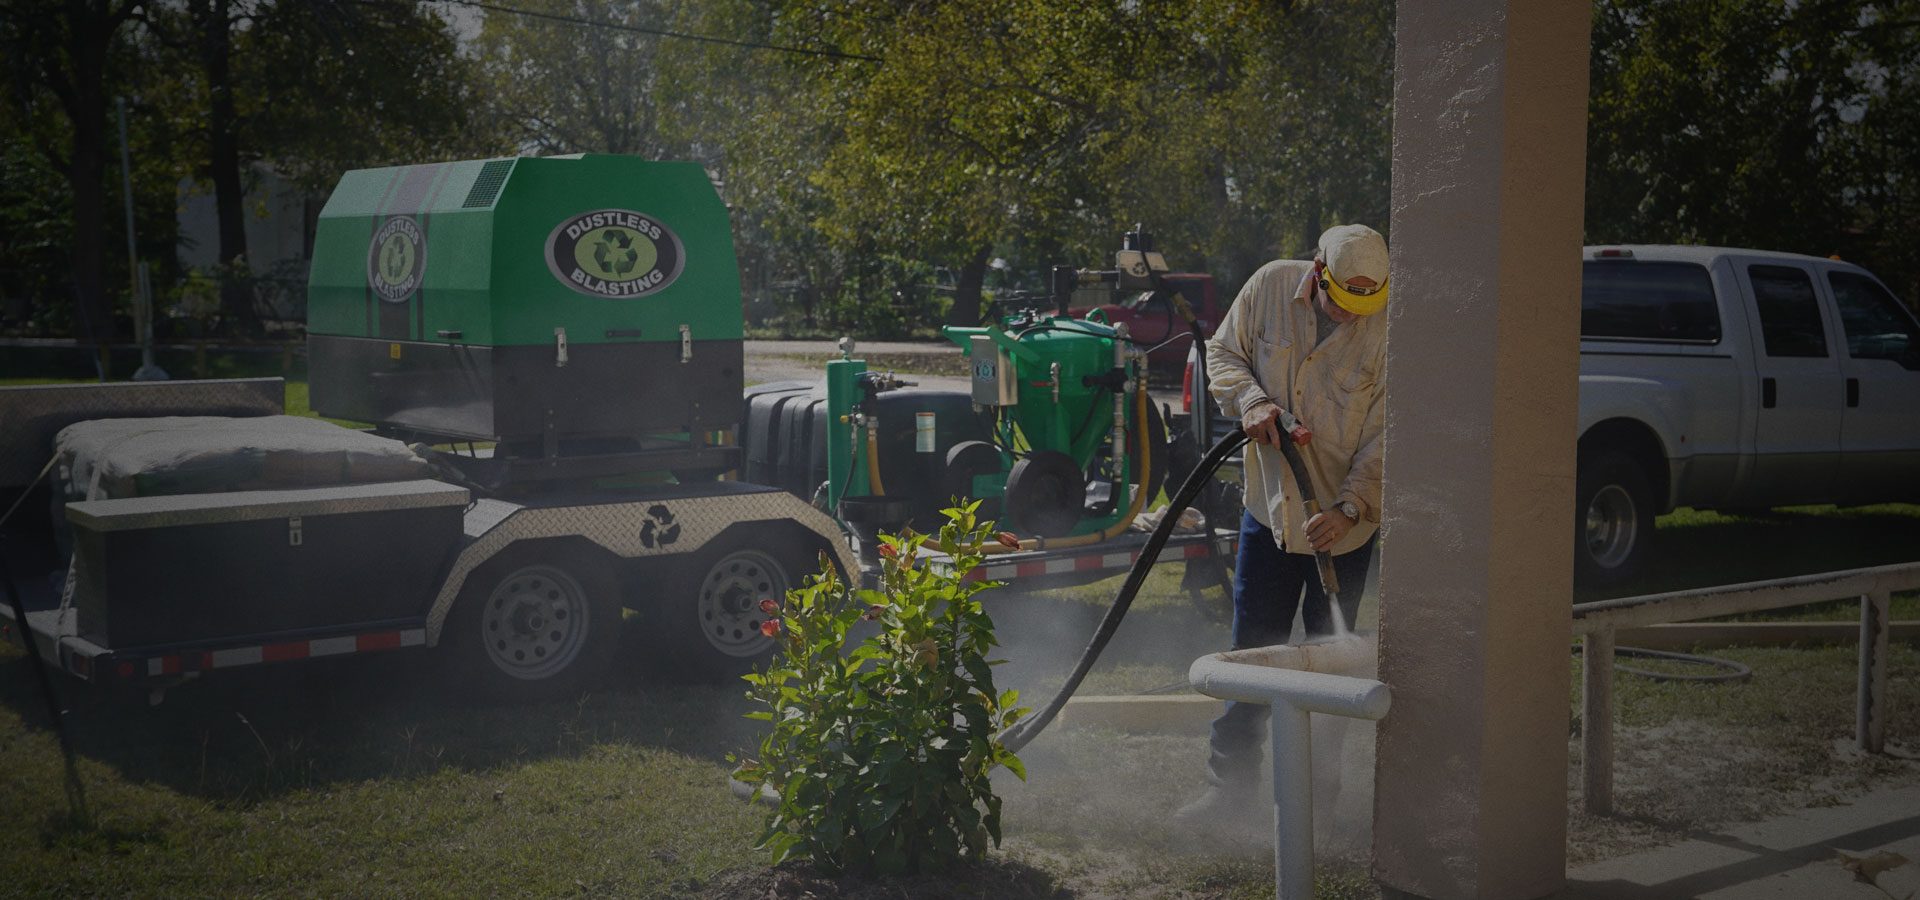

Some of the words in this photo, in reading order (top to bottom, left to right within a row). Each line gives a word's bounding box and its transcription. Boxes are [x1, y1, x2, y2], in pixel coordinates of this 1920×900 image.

[379, 219, 419, 245] DUSTLESS
[566, 213, 661, 240] DUSTLESS
[375, 272, 414, 298] BLASTING
[571, 268, 663, 295] BLASTING
